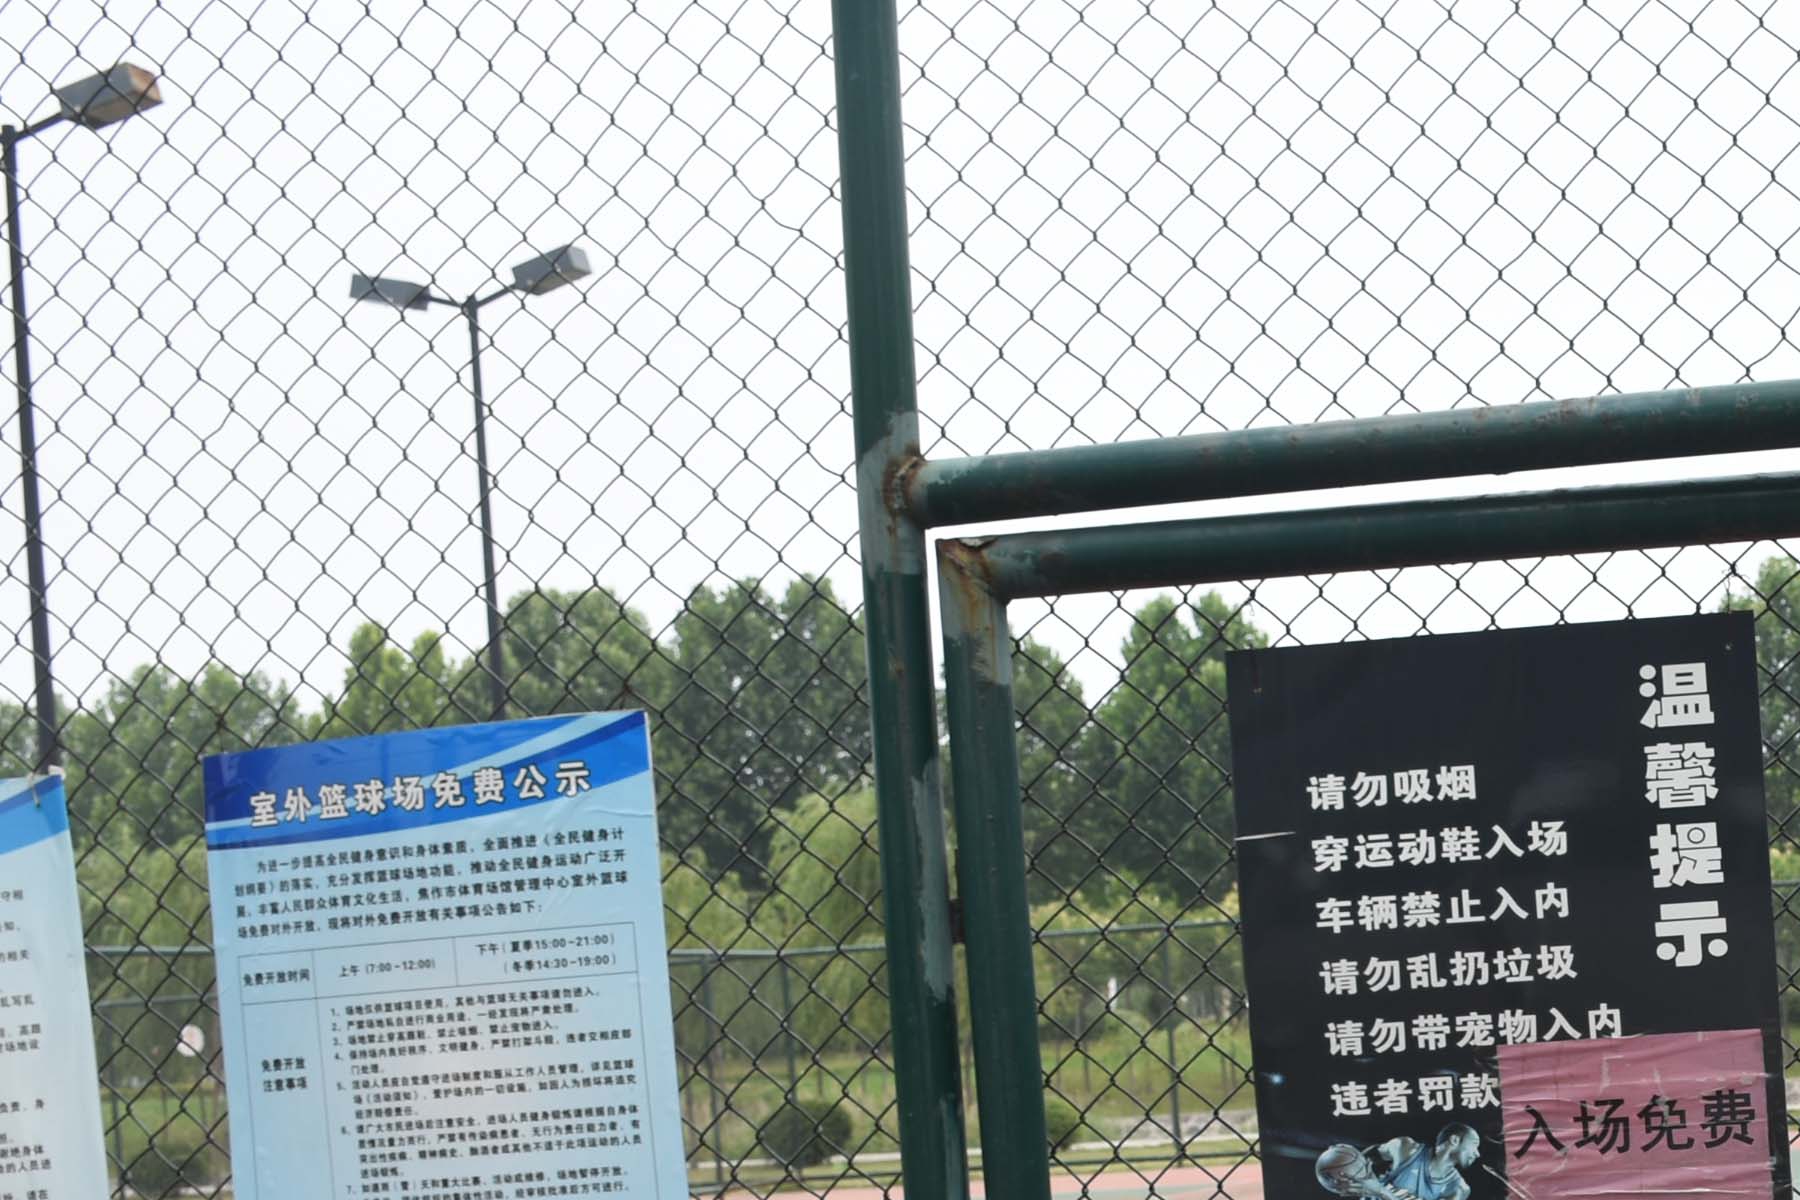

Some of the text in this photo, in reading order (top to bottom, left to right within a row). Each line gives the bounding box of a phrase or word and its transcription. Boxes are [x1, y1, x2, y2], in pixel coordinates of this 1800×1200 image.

[247, 757, 594, 828] 室外篮球场免费公示
[1307, 764, 1477, 812] 请勿吸烟
[1639, 662, 1728, 967] 温馨提示
[1311, 821, 1568, 873] 穿运动鞋入场
[1316, 882, 1569, 934] 车辆禁止入内
[241, 968, 310, 987] 免费开放时间
[1319, 945, 1577, 995] 请勿乱扔垃圾
[1324, 1003, 1622, 1056] 请勿带宠物入内
[260, 1056, 307, 1073] 免费开放
[261, 1075, 308, 1093] 注意事项
[1330, 1073, 1500, 1117] 违者罚款
[1514, 1089, 1755, 1159] 入场免费
